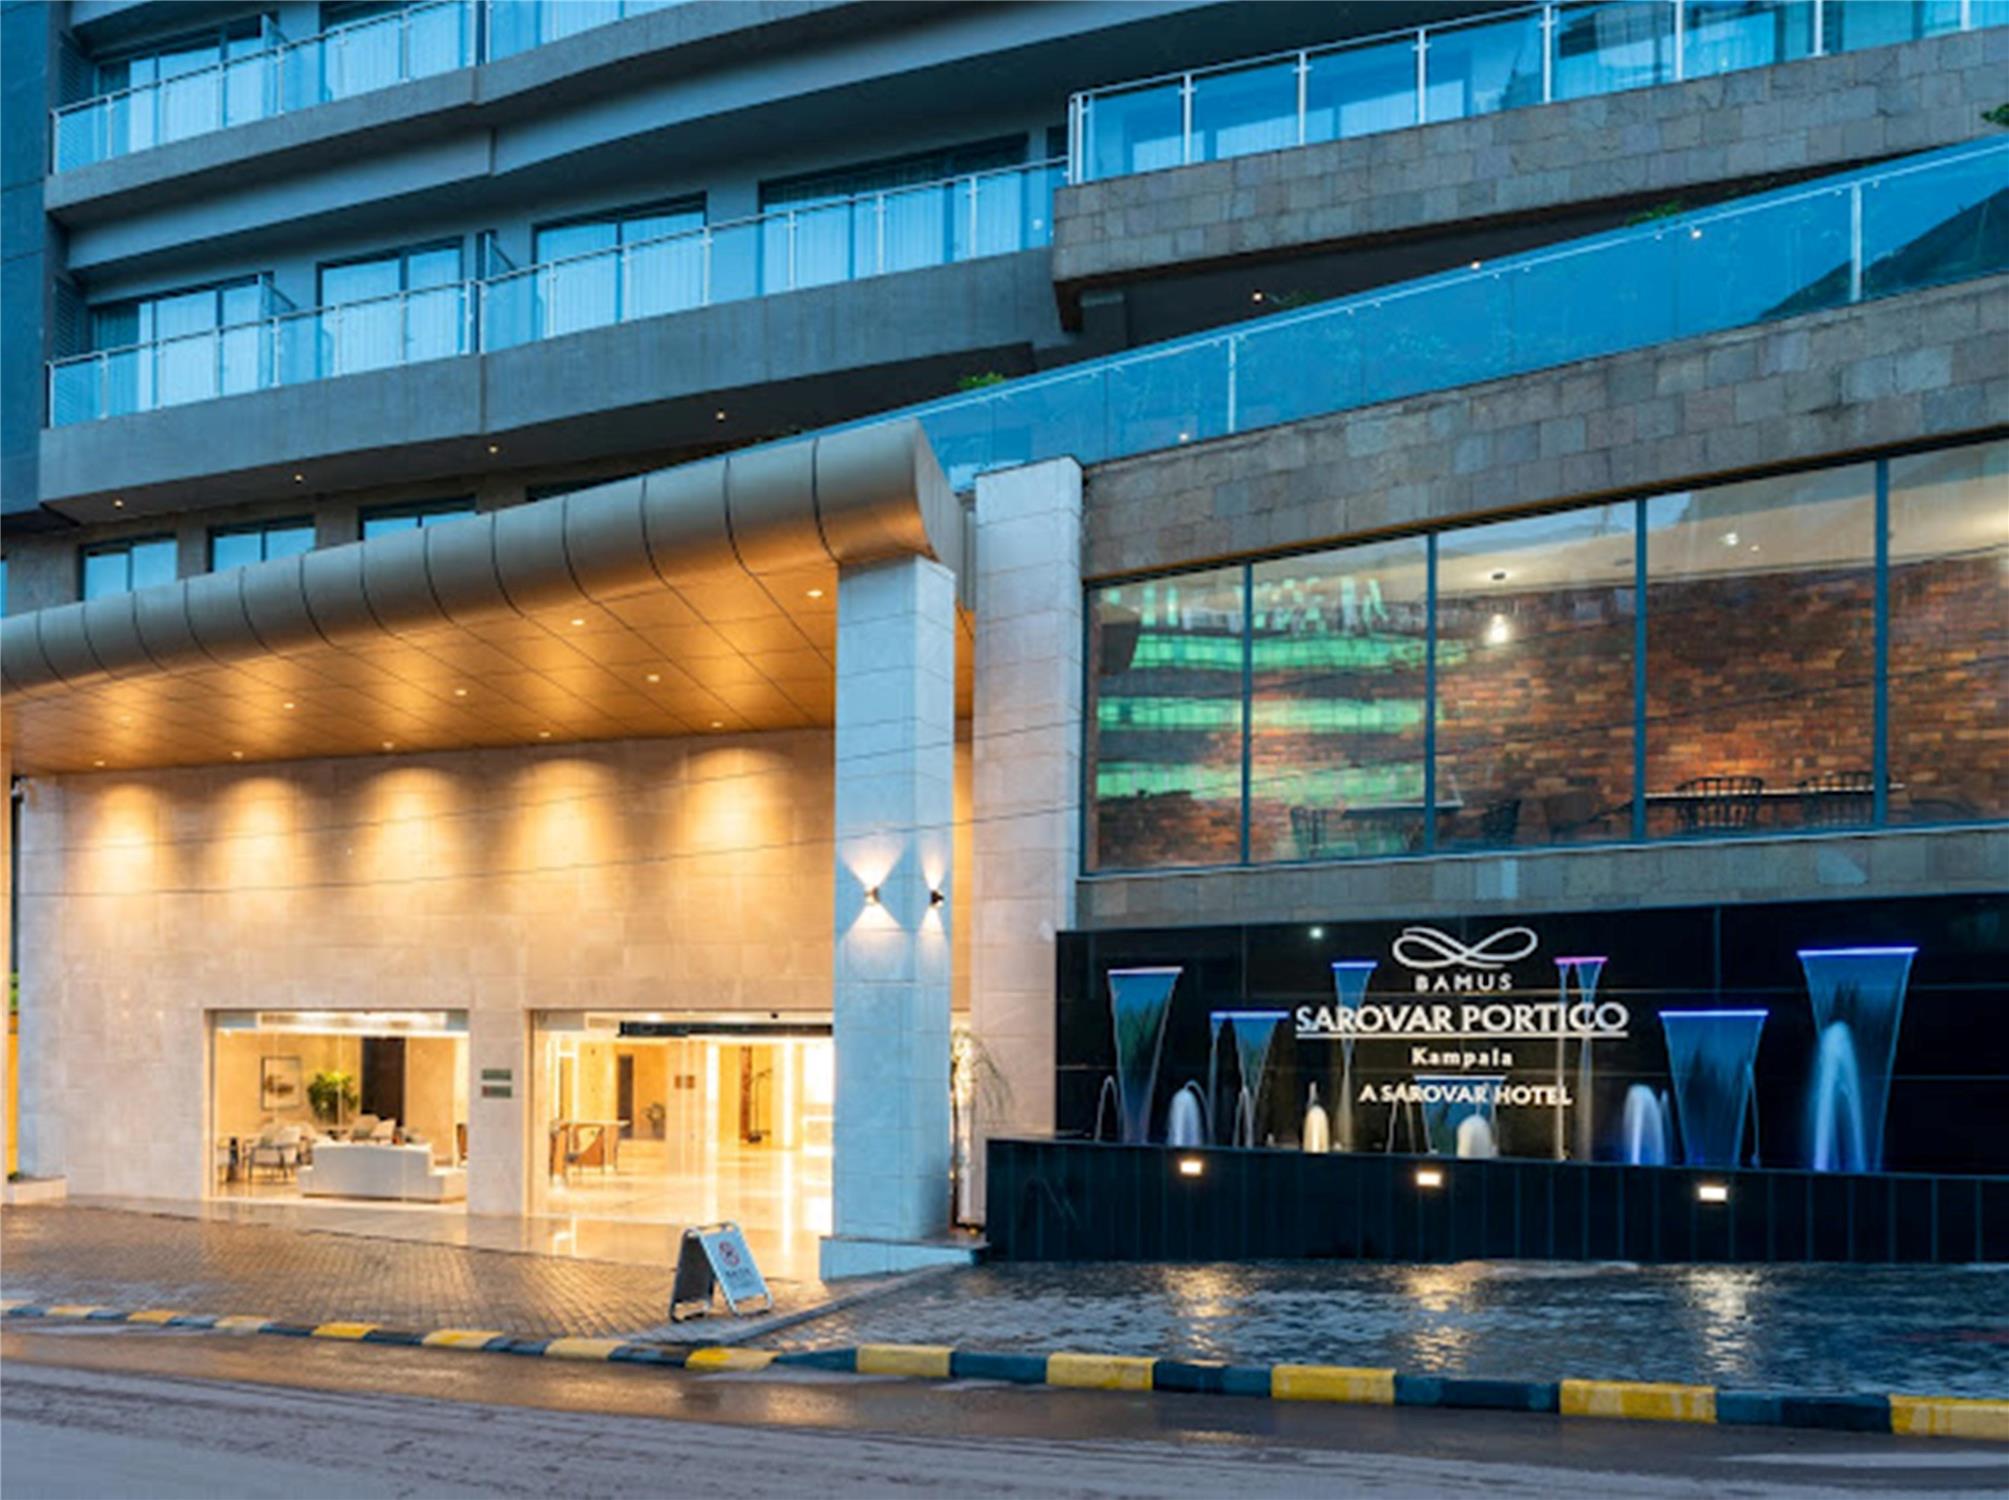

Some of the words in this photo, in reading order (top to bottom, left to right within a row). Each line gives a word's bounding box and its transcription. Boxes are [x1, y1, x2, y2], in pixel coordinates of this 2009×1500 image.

[1415, 974, 1512, 992] BAMUS
[1295, 1005, 1453, 1032] SAROVAR
[1462, 1002, 1629, 1032] PORTICO
[1359, 1086, 1378, 1102] A
[1381, 1085, 1489, 1103] SAROVAR
[1494, 1085, 1573, 1106] HOTEL
